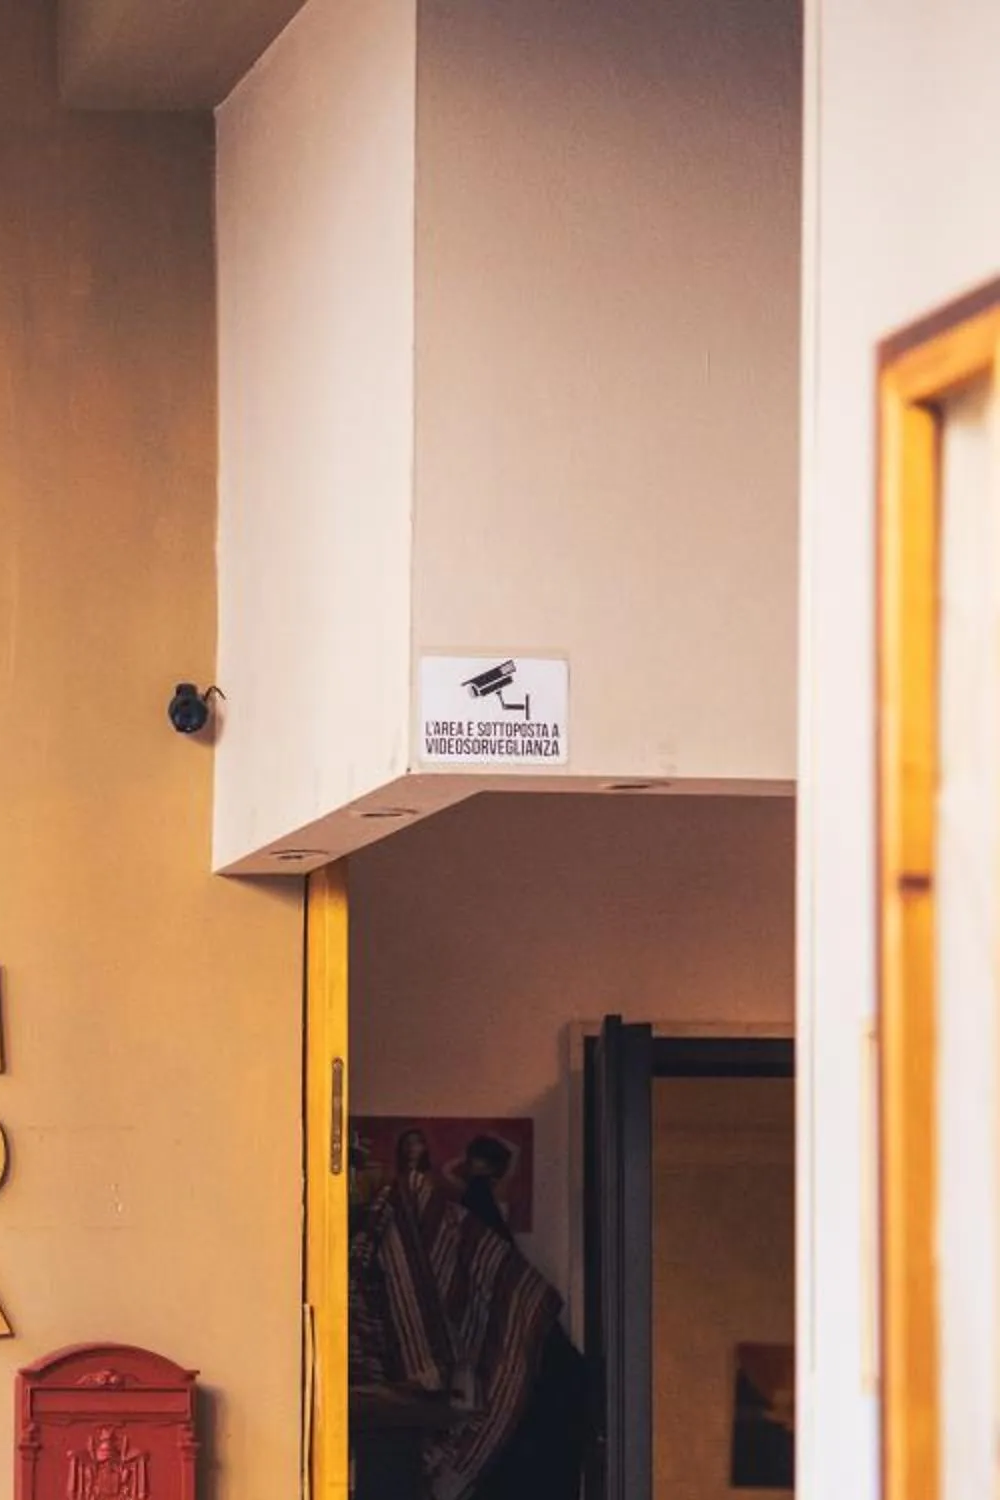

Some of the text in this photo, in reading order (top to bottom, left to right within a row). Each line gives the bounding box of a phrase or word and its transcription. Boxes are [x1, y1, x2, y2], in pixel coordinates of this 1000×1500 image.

[425, 721, 464, 737] L'AREA
[477, 722, 549, 738] SOTTOPOSTA
[551, 723, 560, 738] A
[425, 739, 560, 756] VIDEOSORVEGLIANZA
